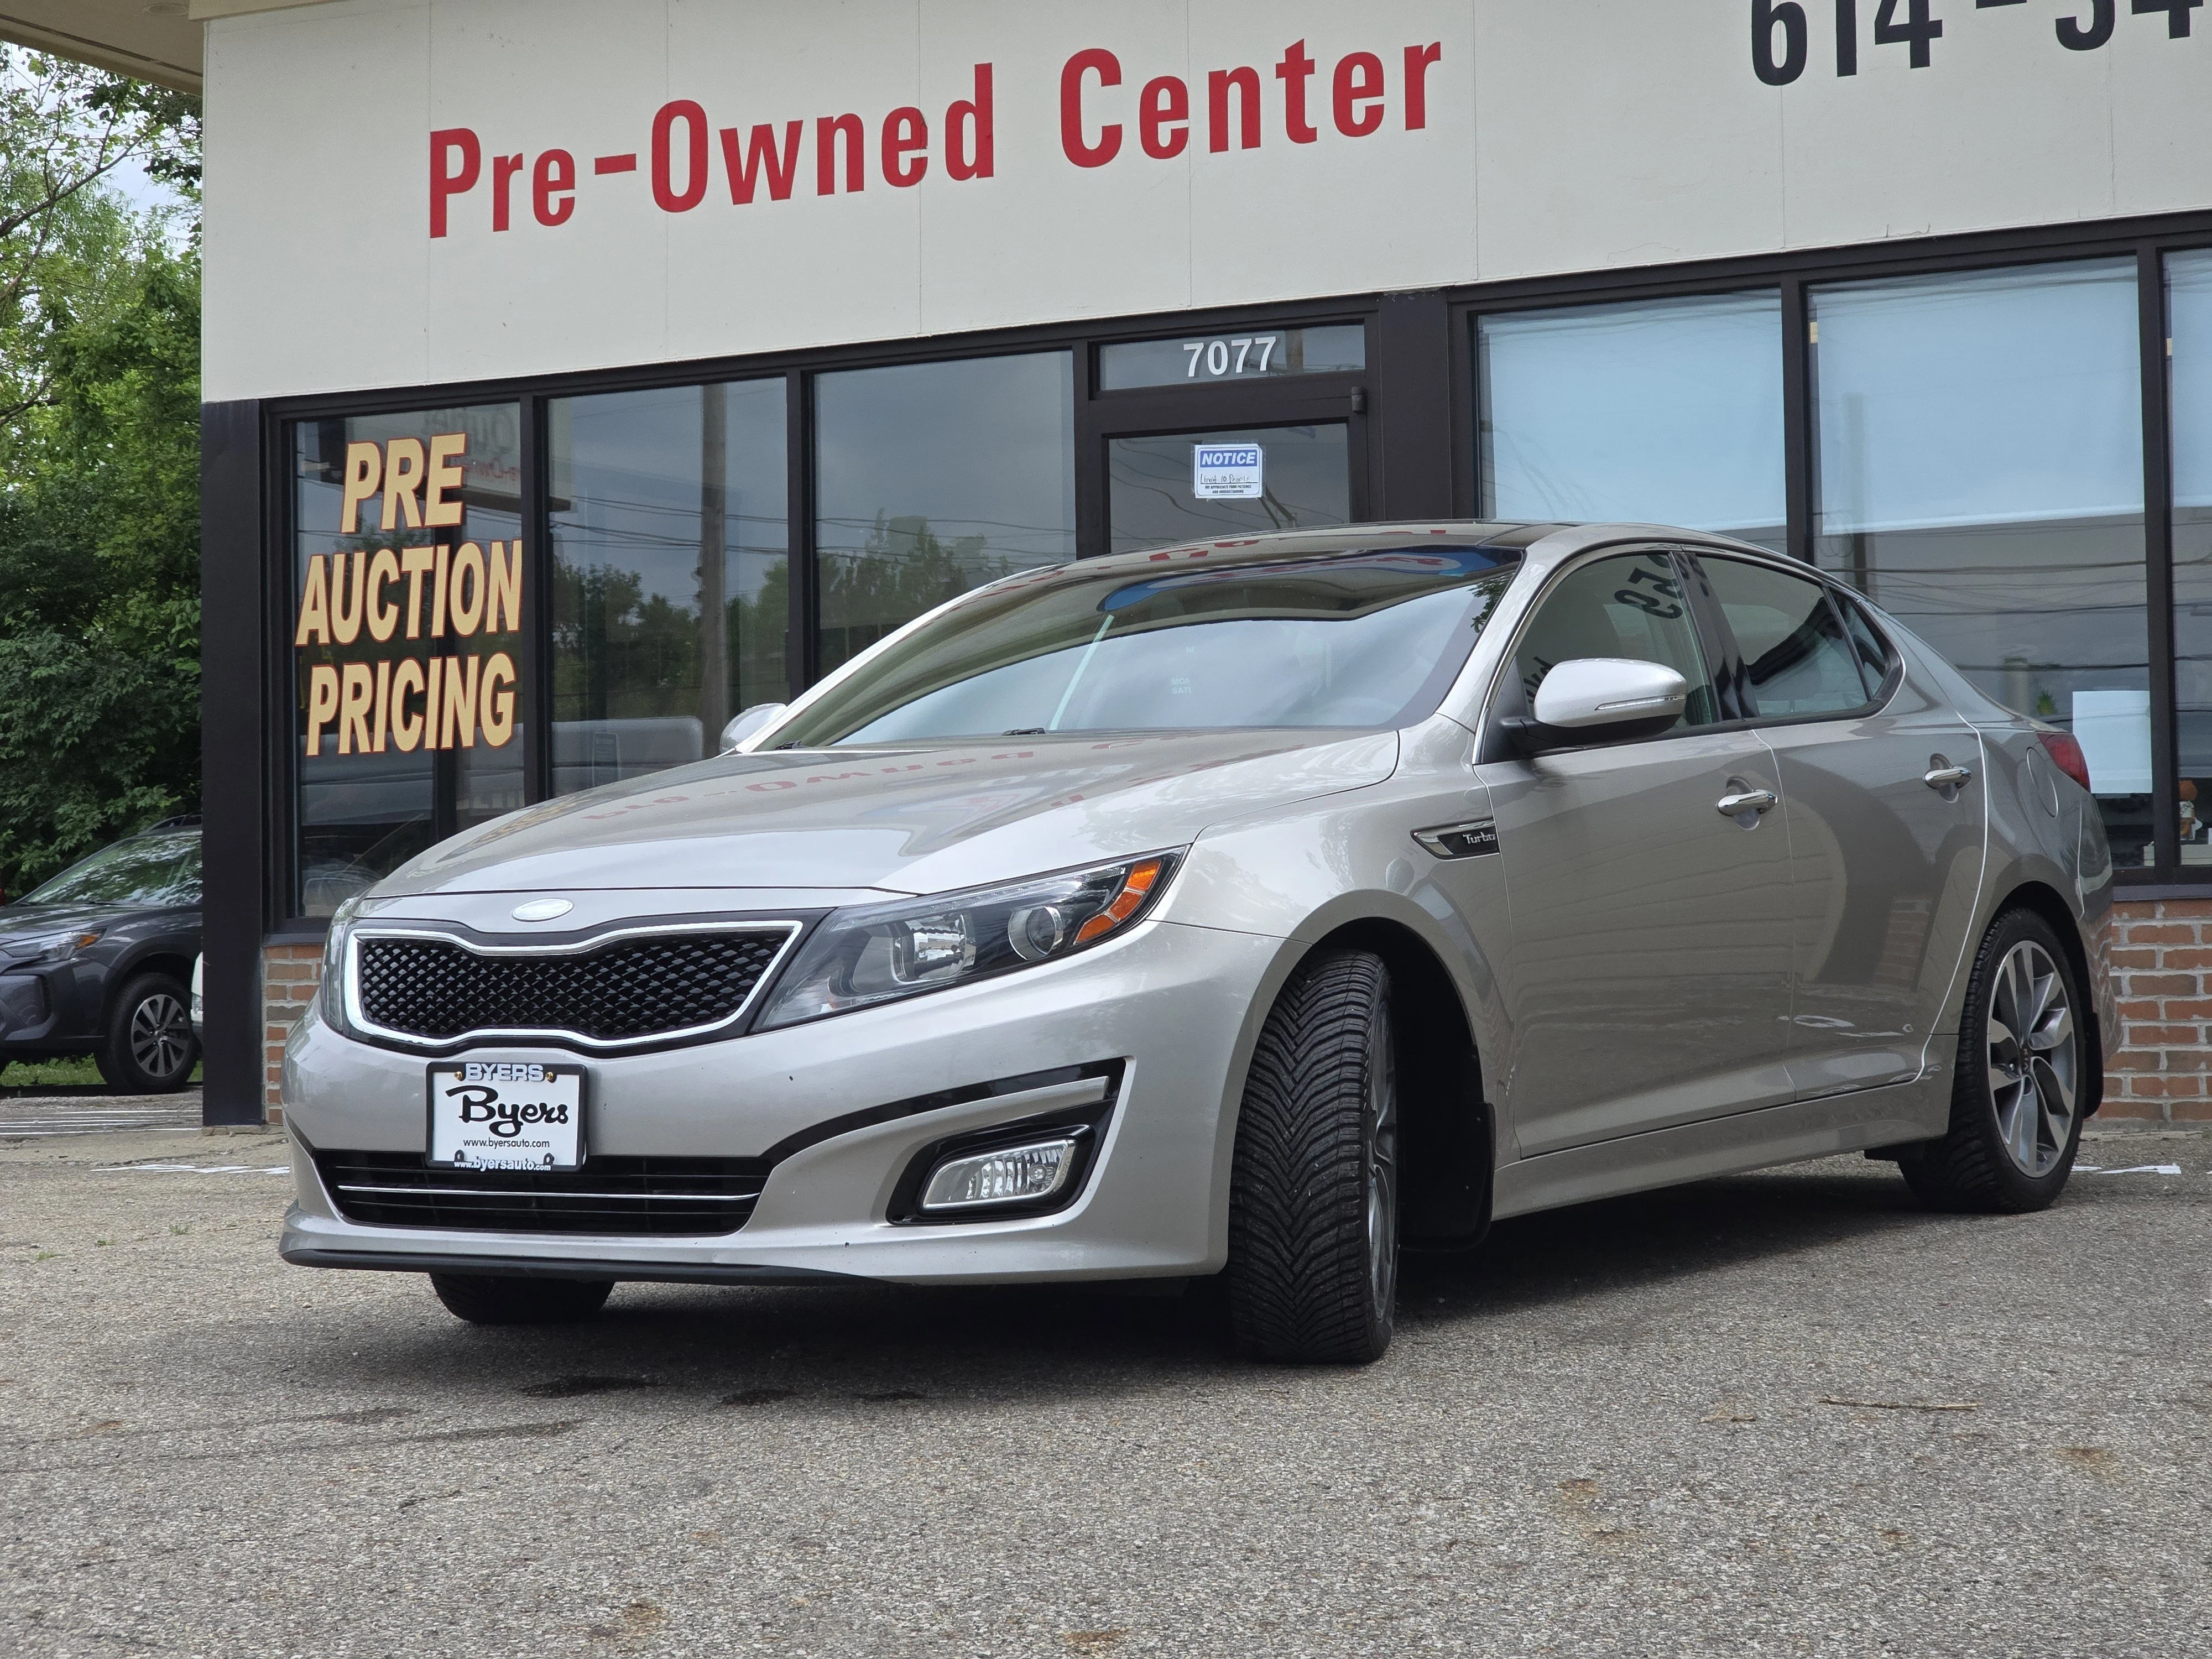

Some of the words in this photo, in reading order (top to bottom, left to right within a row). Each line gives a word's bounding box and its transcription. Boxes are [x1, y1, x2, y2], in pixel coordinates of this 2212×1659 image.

[430, 62, 994, 238] Pre-Owned
[1060, 38, 1441, 168] Center
[1183, 336, 1276, 377] 7077
[1202, 452, 1256, 465] NOTICE
[341, 432, 466, 533] PRE
[295, 538, 522, 646] AUCTION
[306, 652, 515, 757] PRICING
[1463, 832, 1496, 844] Turbo
[465, 1063, 544, 1081] BYERS
[445, 1085, 568, 1138] Byers
[454, 1156, 551, 1171] www.byersauto.com
[463, 1138, 550, 1149] www.byersauto.com
